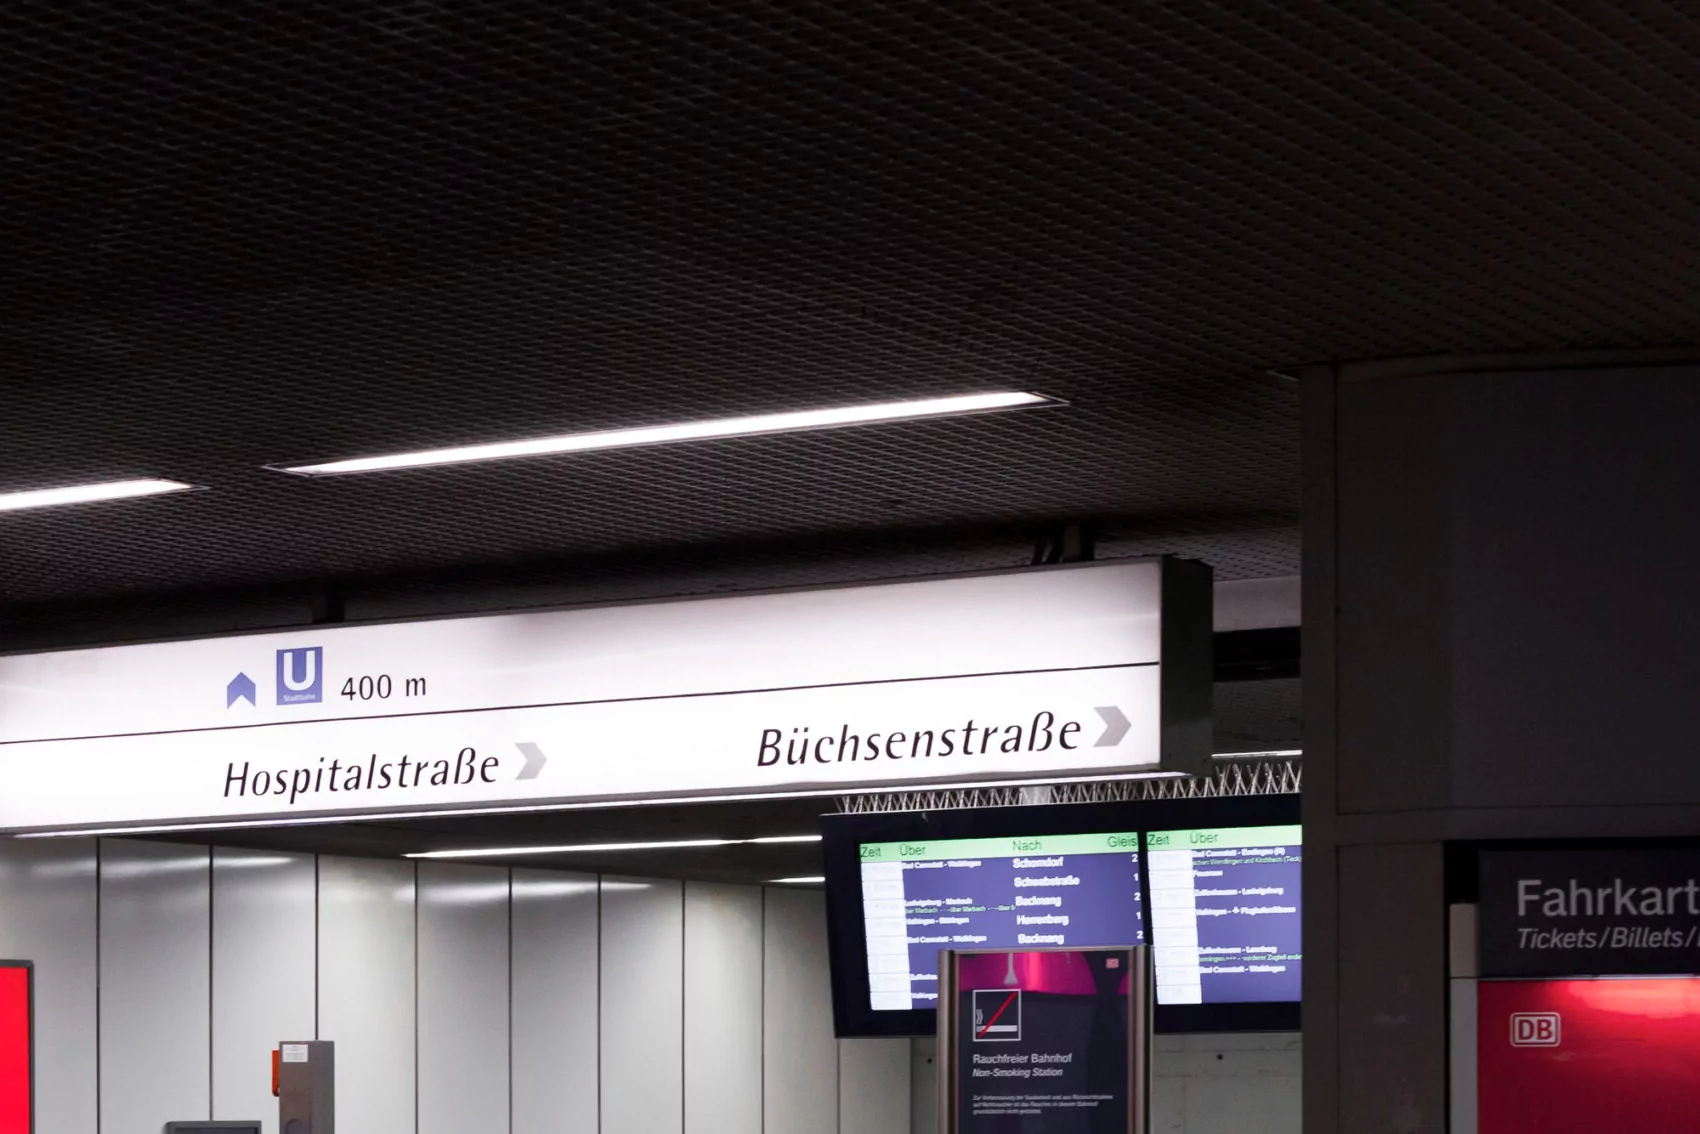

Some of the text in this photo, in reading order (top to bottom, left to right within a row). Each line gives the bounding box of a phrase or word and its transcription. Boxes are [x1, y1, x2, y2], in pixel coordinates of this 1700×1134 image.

[284, 650, 316, 691] U
[341, 674, 426, 701] 400 m
[757, 711, 1082, 767] Büchsenstraße
[224, 747, 499, 805] Hospitalstraße
[861, 836, 1138, 858] Zeit Über Nach Gleis
[1147, 831, 1218, 846] Zeit Über
[1131, 853, 1138, 862] 2
[1133, 873, 1139, 881] 1
[1134, 892, 1141, 901] 2
[1517, 878, 1700, 917] Fahrkart
[1135, 911, 1141, 920] 1
[1136, 930, 1143, 939] 2
[1517, 926, 1700, 949] Tickets/Billets/
[1515, 1017, 1555, 1042] DB
[972, 1052, 1072, 1064] Rauchfreier Bahnhof
[972, 1067, 1063, 1079] Non-Smoking Station
